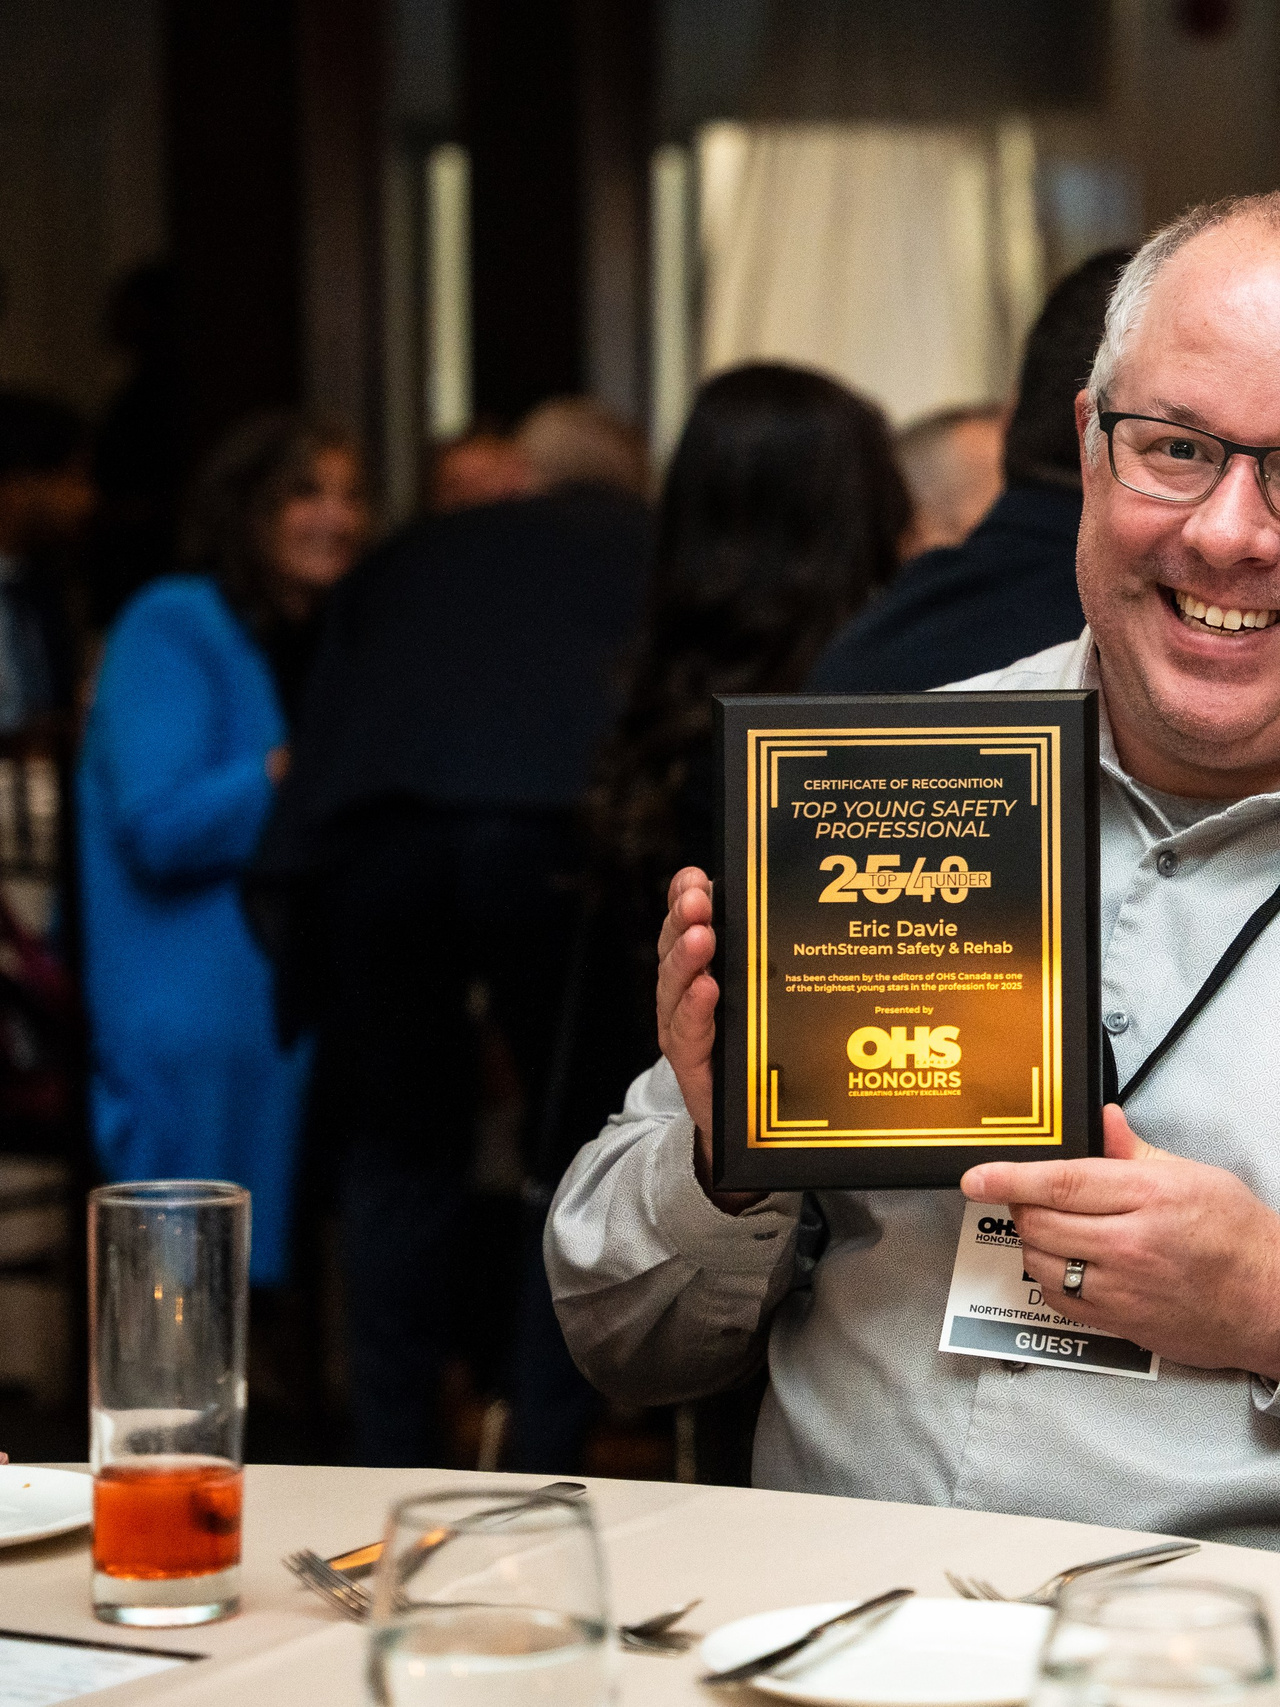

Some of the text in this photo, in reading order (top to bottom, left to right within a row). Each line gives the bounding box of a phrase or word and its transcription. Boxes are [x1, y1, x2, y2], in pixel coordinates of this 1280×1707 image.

[804, 778, 1003, 790] CERTIFICATE OF RECOGNITION
[791, 800, 1017, 818] TOP YOUNG SAFETY
[816, 821, 990, 839] PROFESSIONAL
[869, 873, 988, 887] TOP UNDER
[849, 920, 957, 937] Eric Davie
[793, 942, 1013, 957] NorthStream Safety & Rehab
[863, 974, 873, 983] by
[875, 973, 890, 981] the
[892, 973, 923, 981] editors
[925, 973, 935, 981] of
[786, 982, 1022, 993] of the brightest young stars in the profession for 2025
[875, 1006, 933, 1015] Presented by
[846, 1025, 962, 1069] OHS
[848, 1072, 962, 1088] HONOURS
[975, 1234, 1023, 1246] HONOURS
[969, 1304, 1050, 1322] NORTHSTREAM
[1015, 1332, 1088, 1357] GUEST
